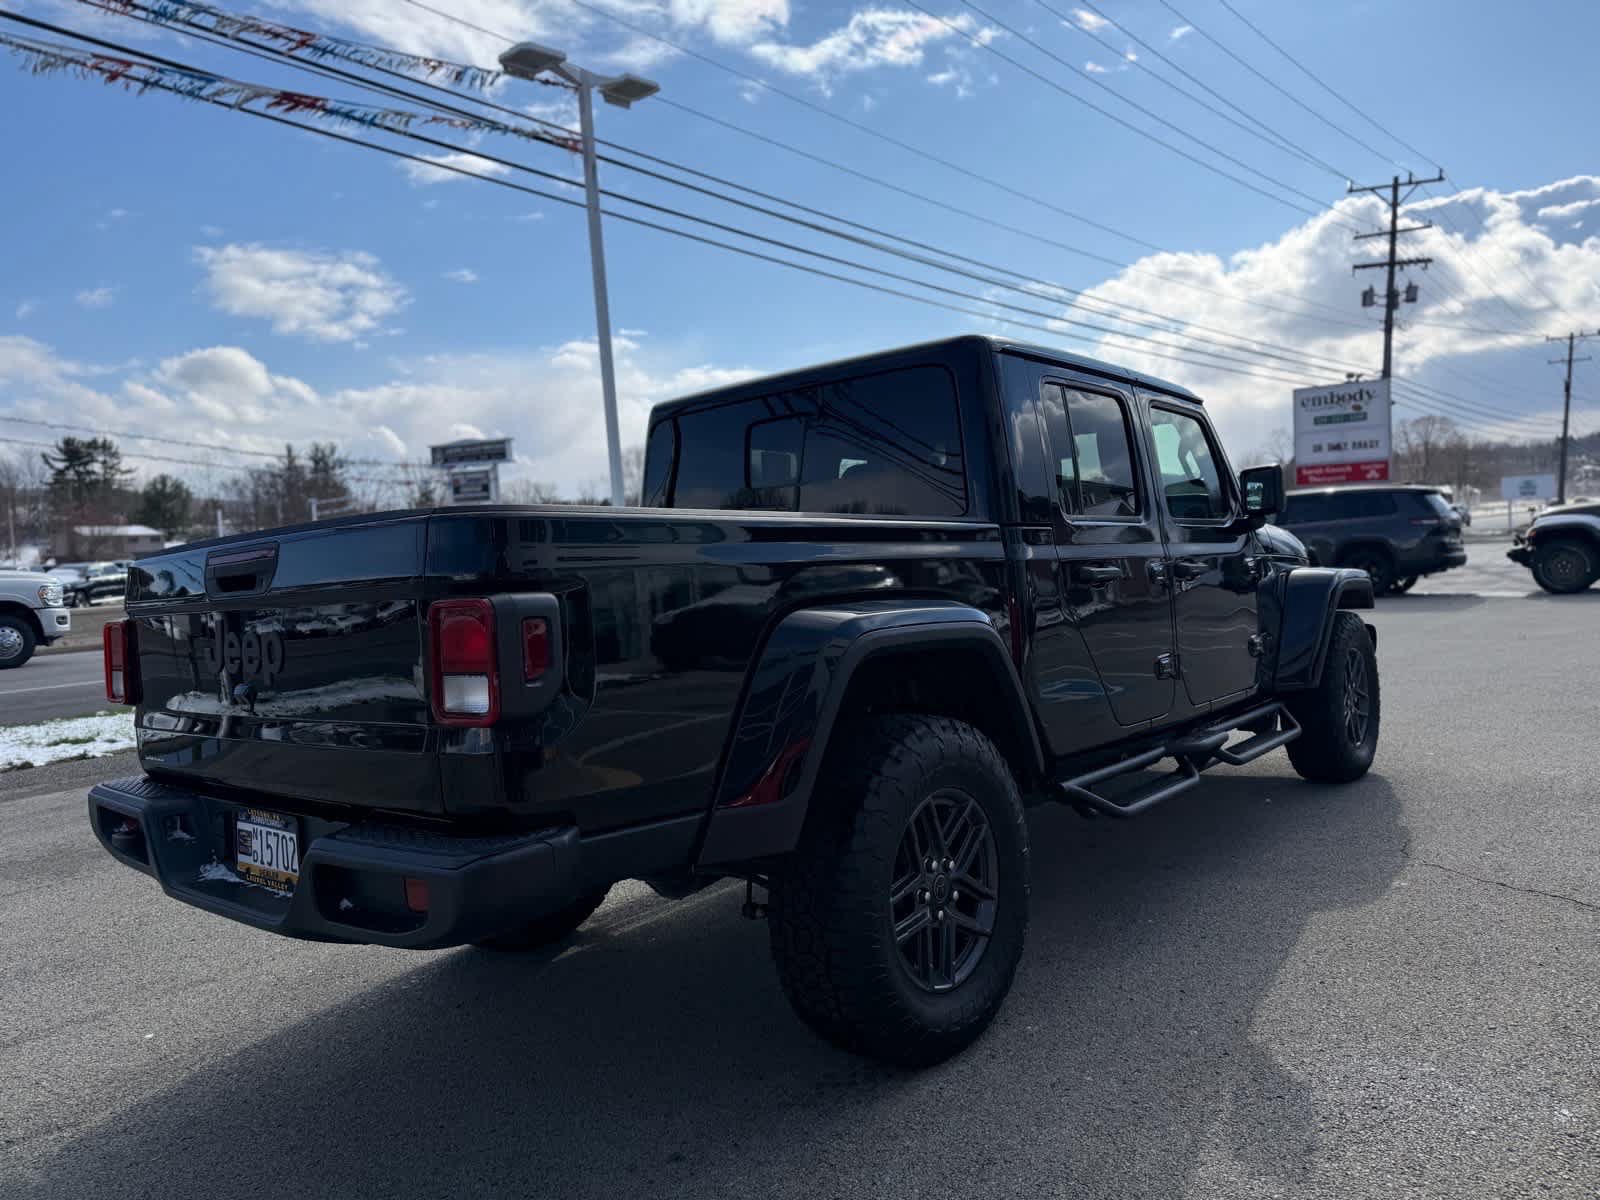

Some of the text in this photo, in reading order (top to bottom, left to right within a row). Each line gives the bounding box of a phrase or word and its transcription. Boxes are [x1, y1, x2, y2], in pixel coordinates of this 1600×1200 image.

[1301, 388, 1376, 408] embody
[205, 613, 284, 687] Jeep
[259, 829, 298, 873] 15702
